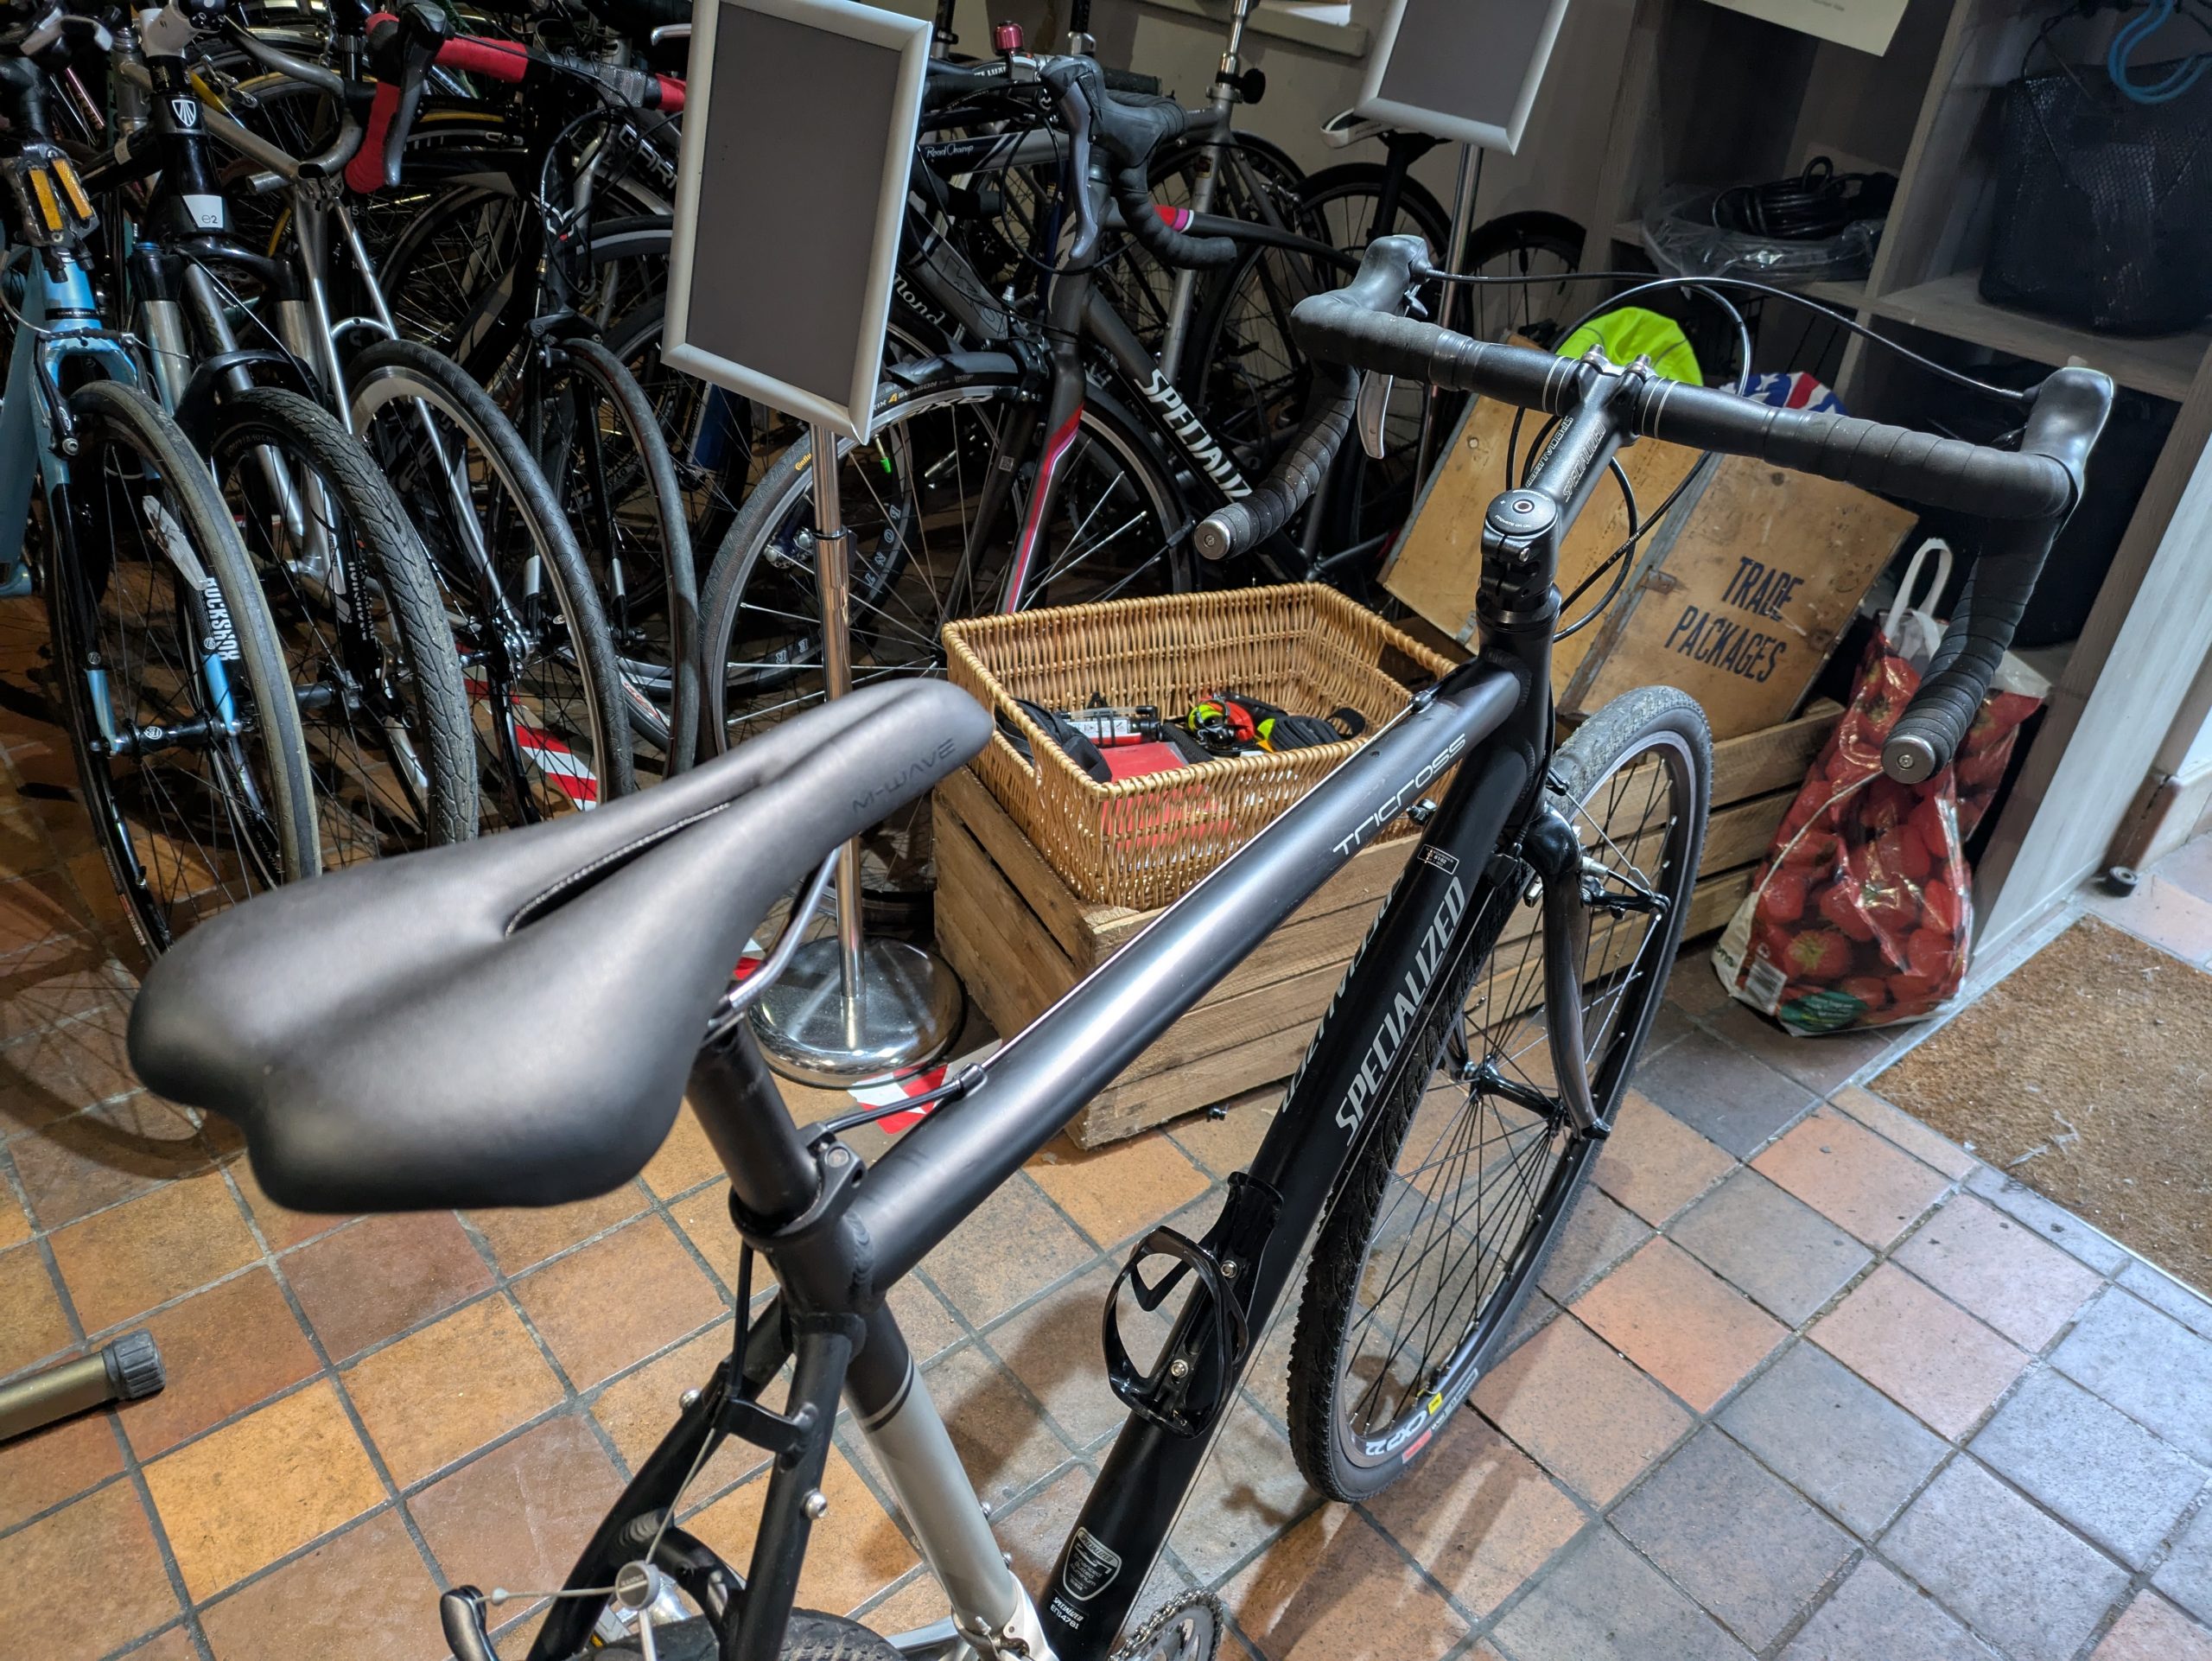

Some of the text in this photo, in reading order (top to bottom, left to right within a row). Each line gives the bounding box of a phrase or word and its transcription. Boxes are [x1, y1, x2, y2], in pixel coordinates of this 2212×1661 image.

[1562, 419, 1607, 503] SPECIALIZED
[206, 576, 241, 662] ROCKSHOX
[1721, 556, 1804, 622] TRADE
[1664, 605, 1787, 683] PACKAGES
[852, 737, 956, 813] M-WAVE
[1335, 875, 1466, 1147] SPECIALIZED
[1052, 1596, 1084, 1622] SPECIALIZED
